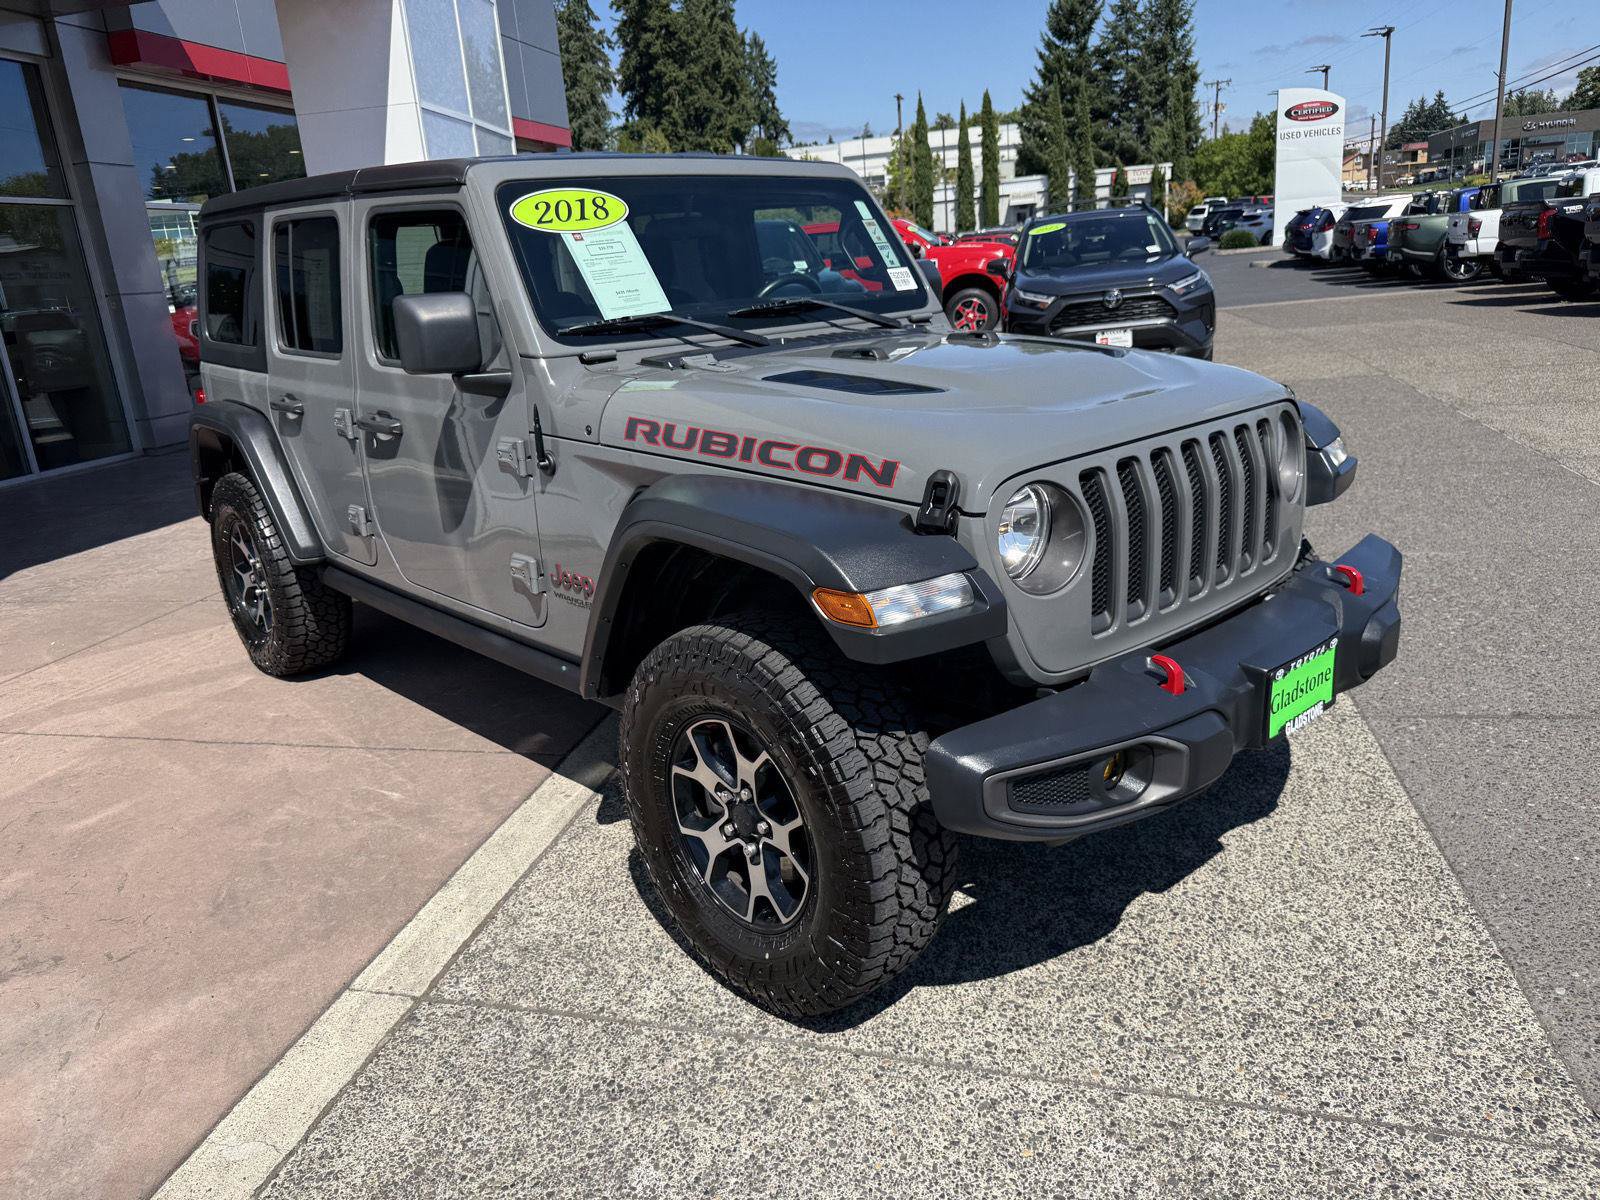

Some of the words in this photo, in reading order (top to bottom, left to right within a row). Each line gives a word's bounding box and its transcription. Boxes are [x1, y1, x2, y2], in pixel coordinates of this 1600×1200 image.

[1280, 131, 1301, 140] USED
[1304, 127, 1341, 138] VEHICLES
[1538, 118, 1576, 128] HYUNDAI
[534, 196, 610, 225] 2018
[624, 416, 901, 488] RUBICON
[549, 562, 595, 600] Jeep
[1290, 645, 1326, 672] TOYOTA
[1271, 667, 1332, 715] Gladstone
[1285, 701, 1324, 736] GLADSTONE
